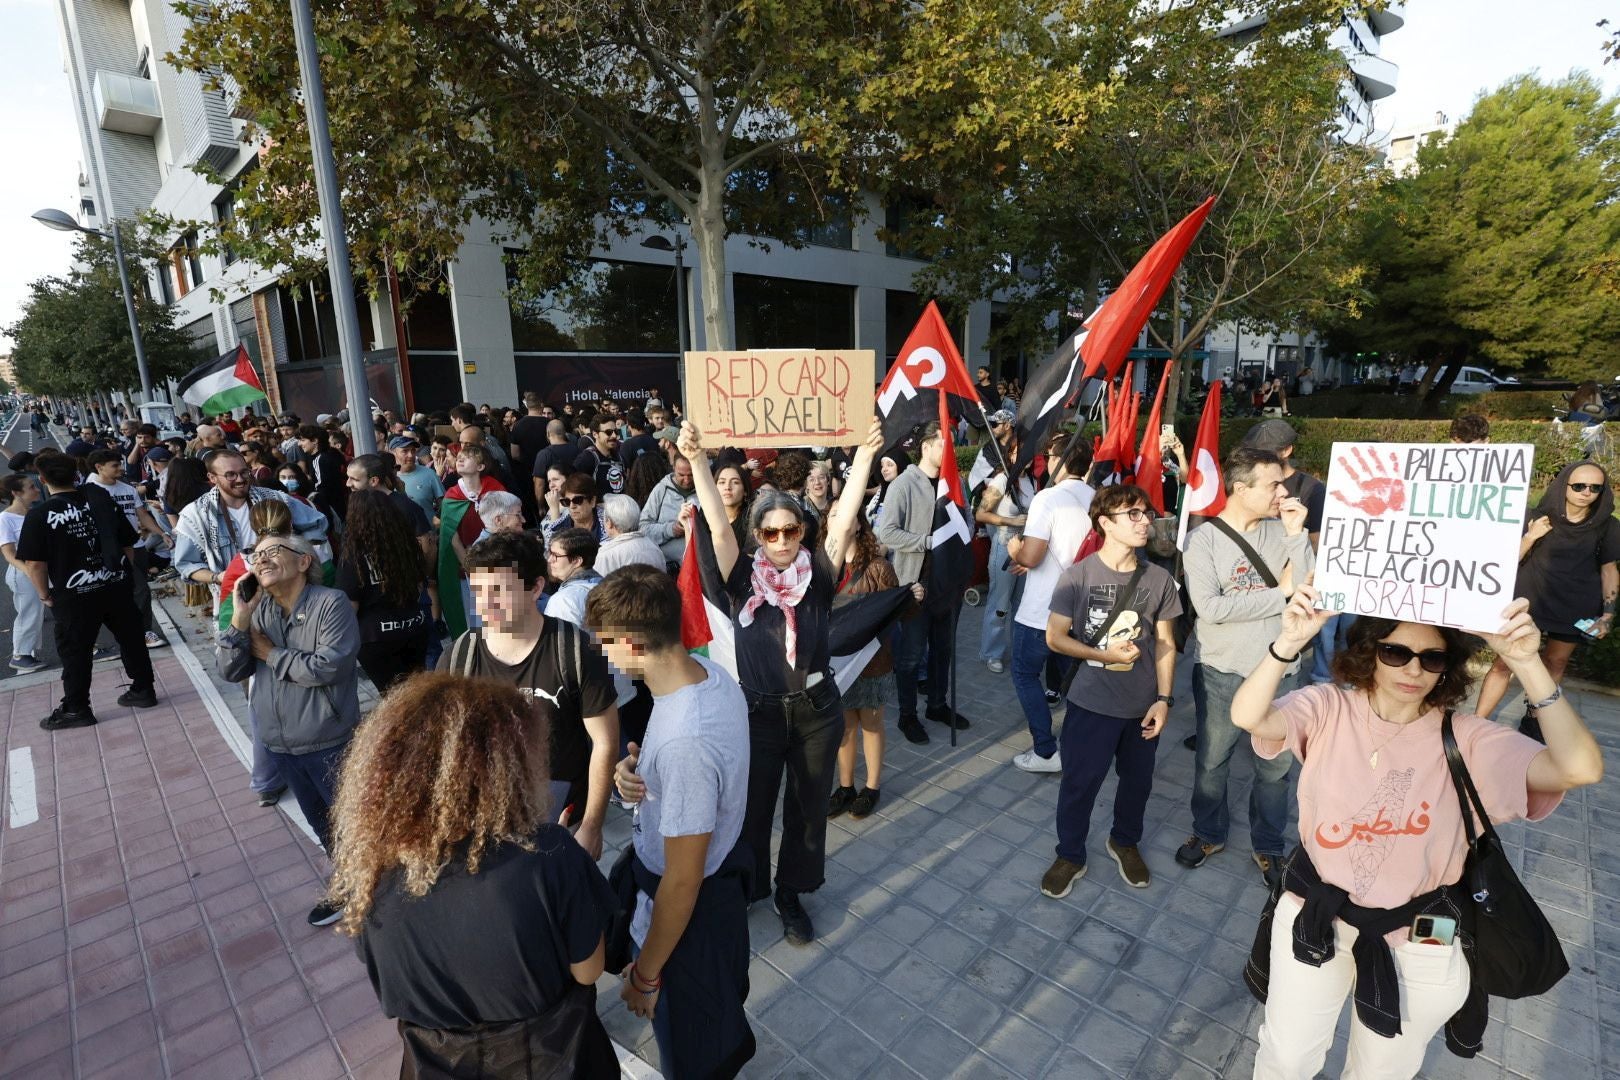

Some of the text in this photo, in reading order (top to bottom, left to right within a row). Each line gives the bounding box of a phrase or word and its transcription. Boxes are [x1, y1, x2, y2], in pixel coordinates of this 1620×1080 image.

[706, 356, 851, 399] RED CARD
[730, 397, 835, 436] ISRAEL
[1354, 579, 1464, 628] ISRAEL
[1315, 800, 1430, 849] فلسطين
